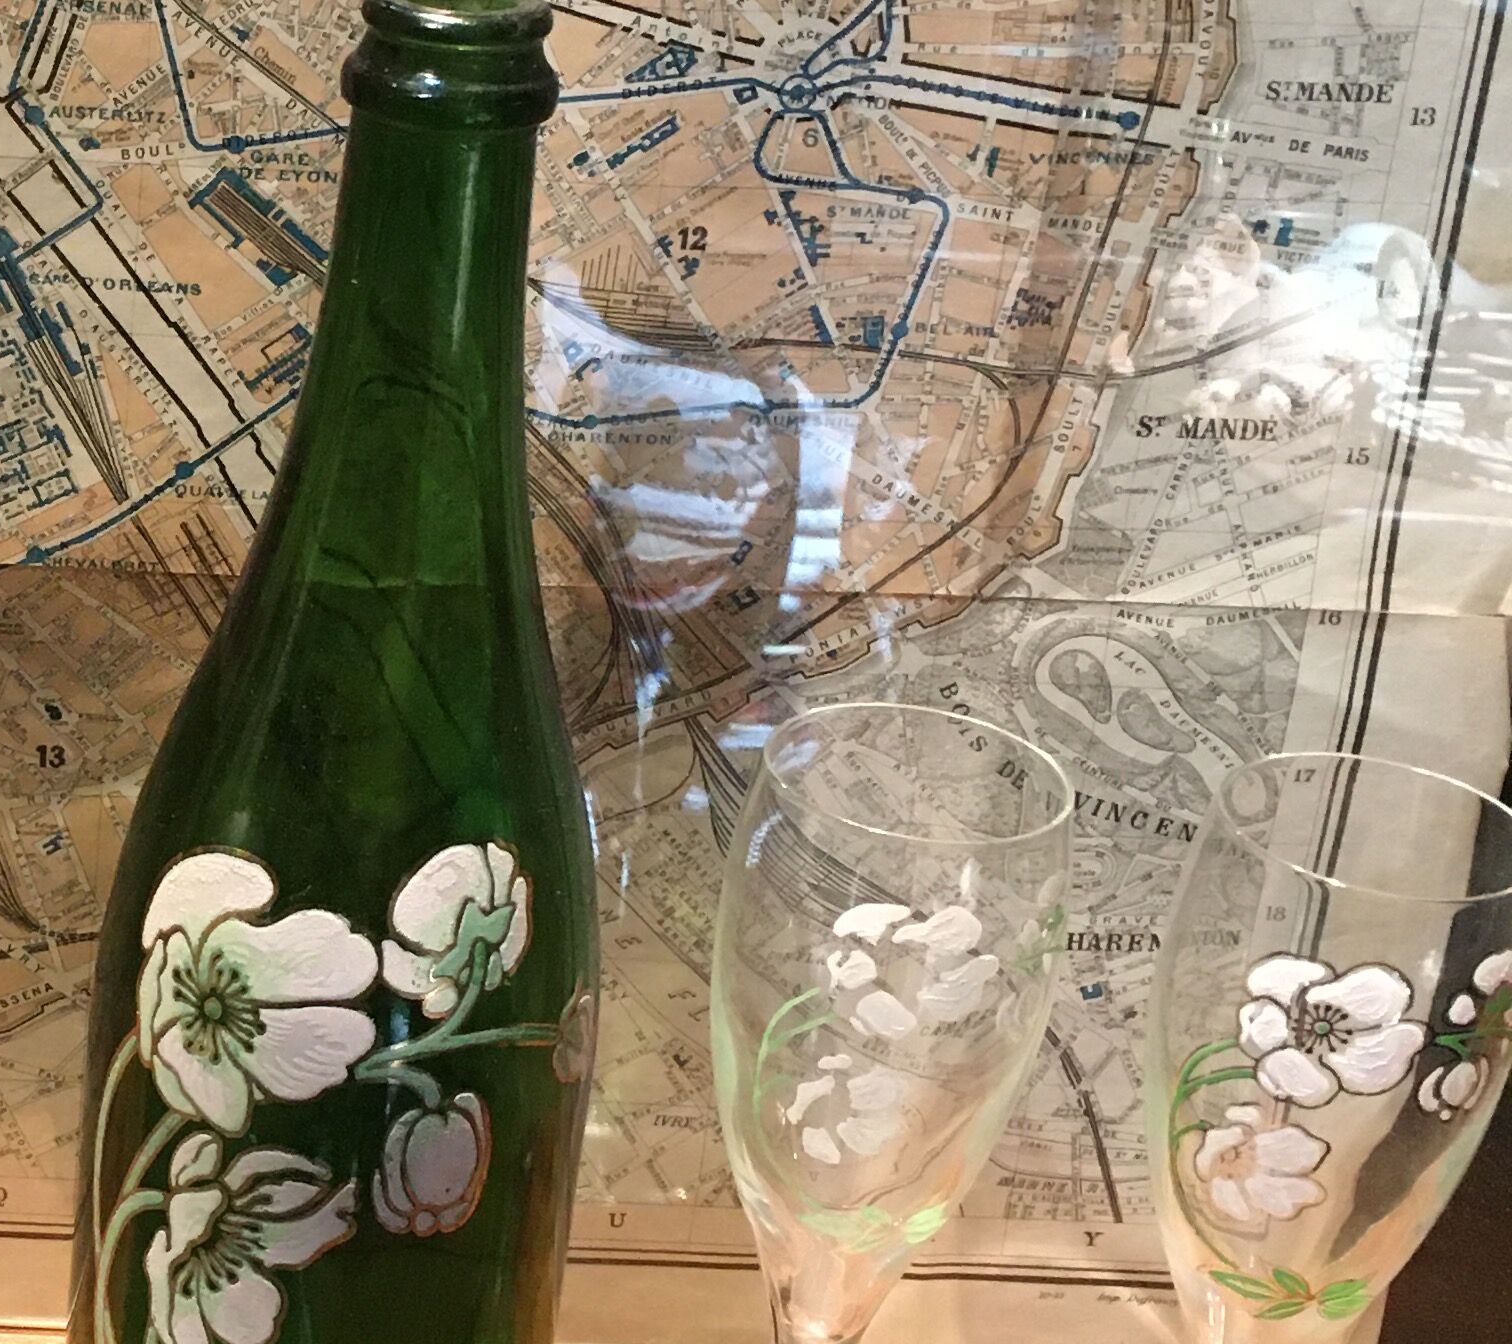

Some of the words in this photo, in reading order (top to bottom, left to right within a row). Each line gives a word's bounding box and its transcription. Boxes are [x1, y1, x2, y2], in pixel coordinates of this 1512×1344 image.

[171, 8, 242, 68] AVENUE
[622, 76, 717, 100] DIDEROT
[49, 104, 167, 124] AUSTERLITZ
[1409, 106, 1437, 129] 13
[802, 128, 820, 149] 6
[250, 151, 311, 167] GARE
[1287, 138, 1313, 155] DE
[1322, 142, 1371, 164] PARIS
[239, 166, 270, 183] DE
[277, 167, 339, 186] LYON
[956, 202, 1017, 224] SAINT
[677, 226, 709, 253] 12
[1053, 395, 1085, 455] SOULT
[546, 429, 674, 448] CHARENTON
[1342, 445, 1372, 467] 15
[870, 471, 985, 551] DAUMESNIL
[1120, 516, 1166, 596] BOULEVARD
[1138, 562, 1197, 590] AVENUE
[1116, 608, 1177, 630] AVENUE
[1316, 607, 1343, 627] 16
[938, 679, 988, 754] BOIS
[995, 760, 1029, 794] DE
[35, 744, 67, 769] 13
[1292, 768, 1317, 785] 17
[1264, 905, 1288, 923] 18
[607, 1211, 628, 1229] U
[1083, 1230, 1105, 1247] Y
